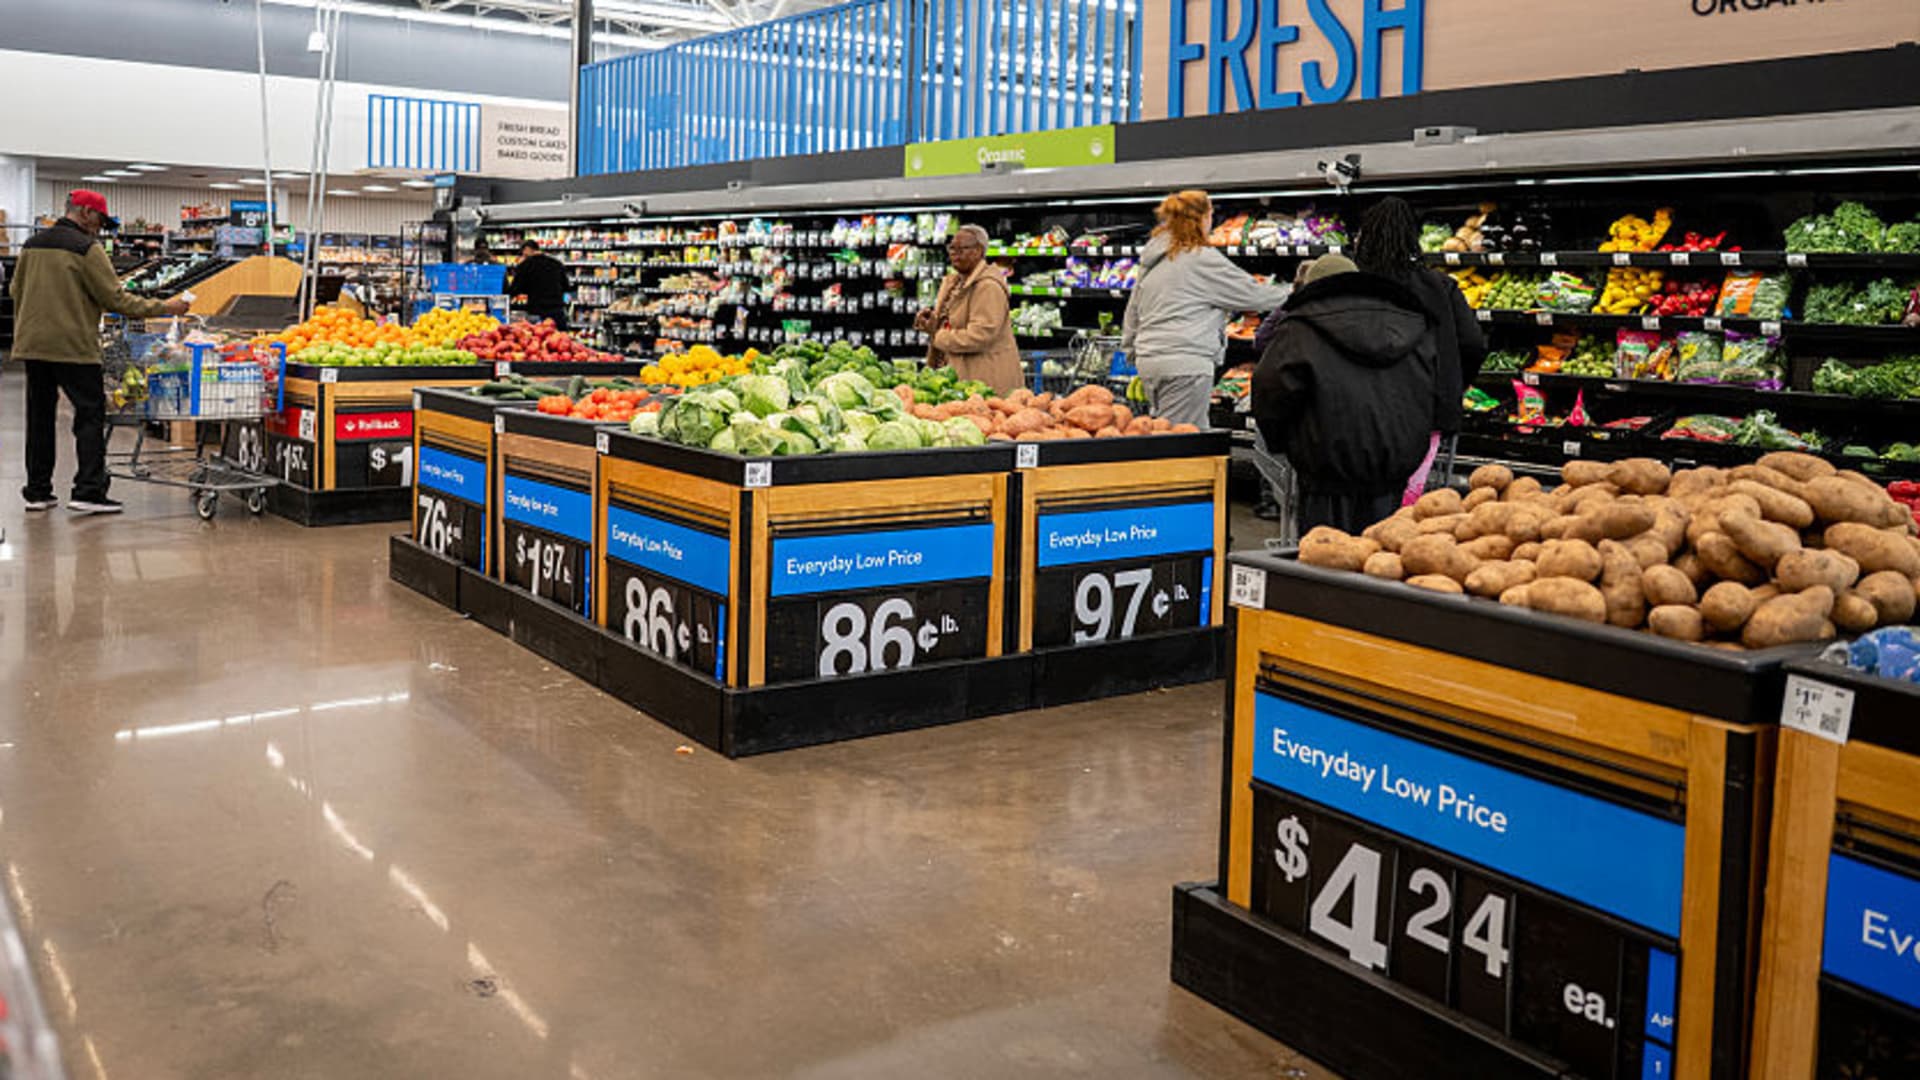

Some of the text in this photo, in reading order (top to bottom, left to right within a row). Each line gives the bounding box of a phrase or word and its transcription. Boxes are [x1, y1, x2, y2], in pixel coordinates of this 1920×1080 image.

[1167, 0, 1424, 119] FRESH
[612, 524, 643, 551] Everyday
[1049, 524, 1157, 548] Everyday Low Price
[787, 549, 922, 577] Everyday Low Price
[941, 615, 959, 633] lb.
[1272, 727, 1508, 833] Everyday Low Price
[1563, 982, 1615, 1029] ea.
